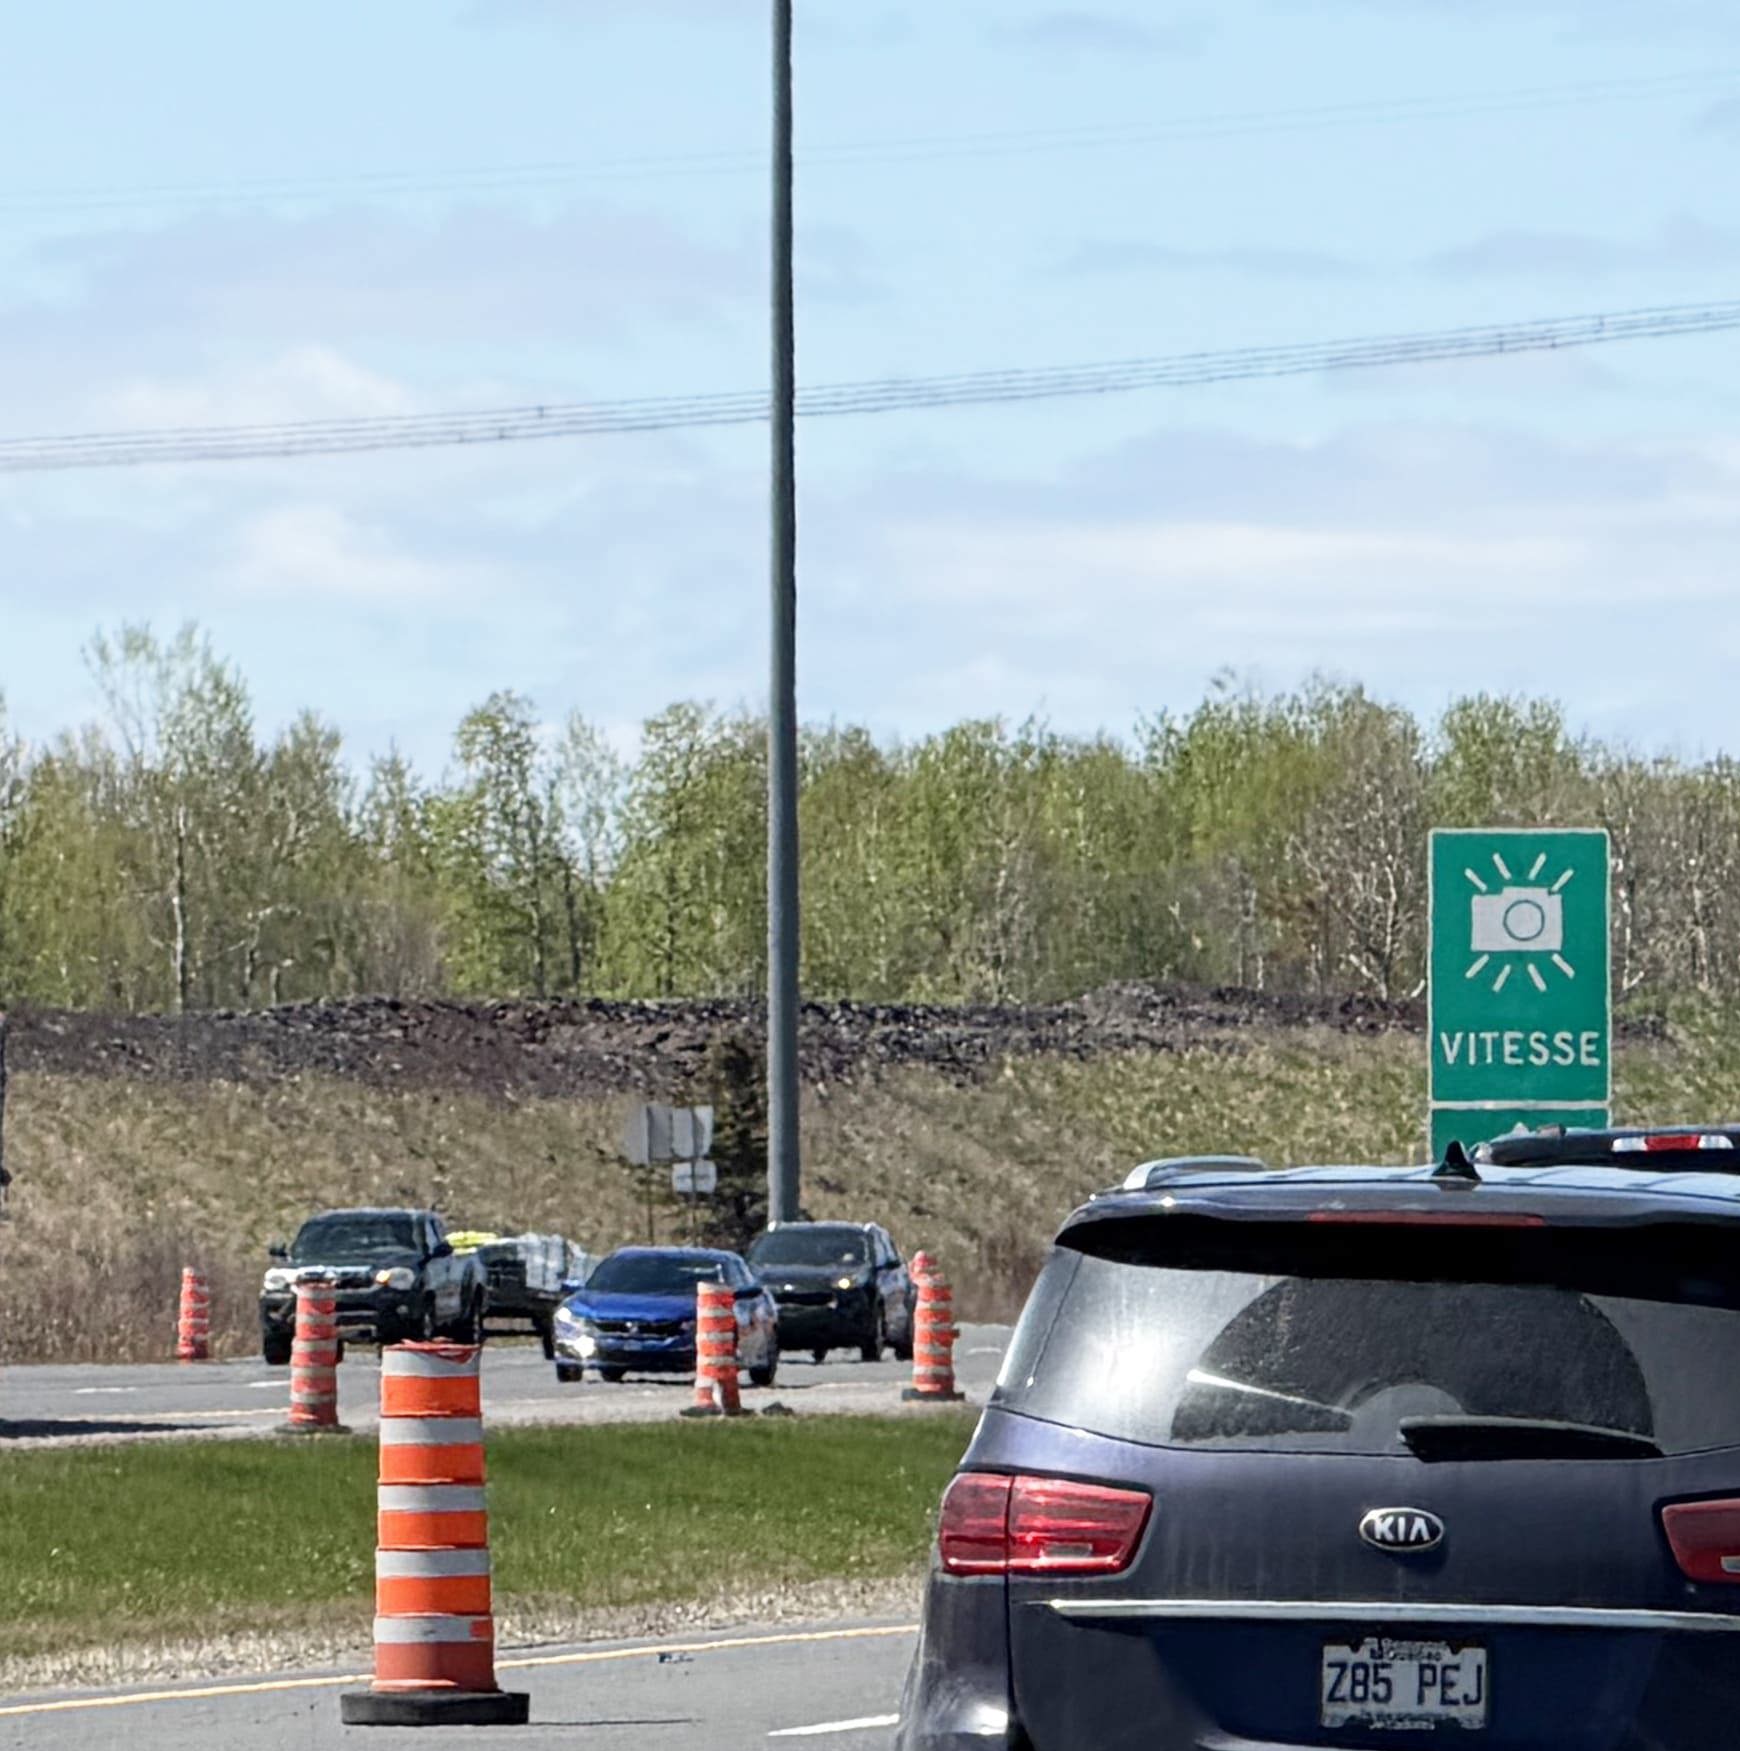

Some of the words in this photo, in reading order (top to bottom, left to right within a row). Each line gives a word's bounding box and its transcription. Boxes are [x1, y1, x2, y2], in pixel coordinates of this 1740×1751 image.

[1439, 1030, 1601, 1067] VITESSE
[1373, 1515, 1431, 1542] KIA
[1327, 1661, 1393, 1704] Z85
[1416, 1663, 1483, 1706] PEJ
